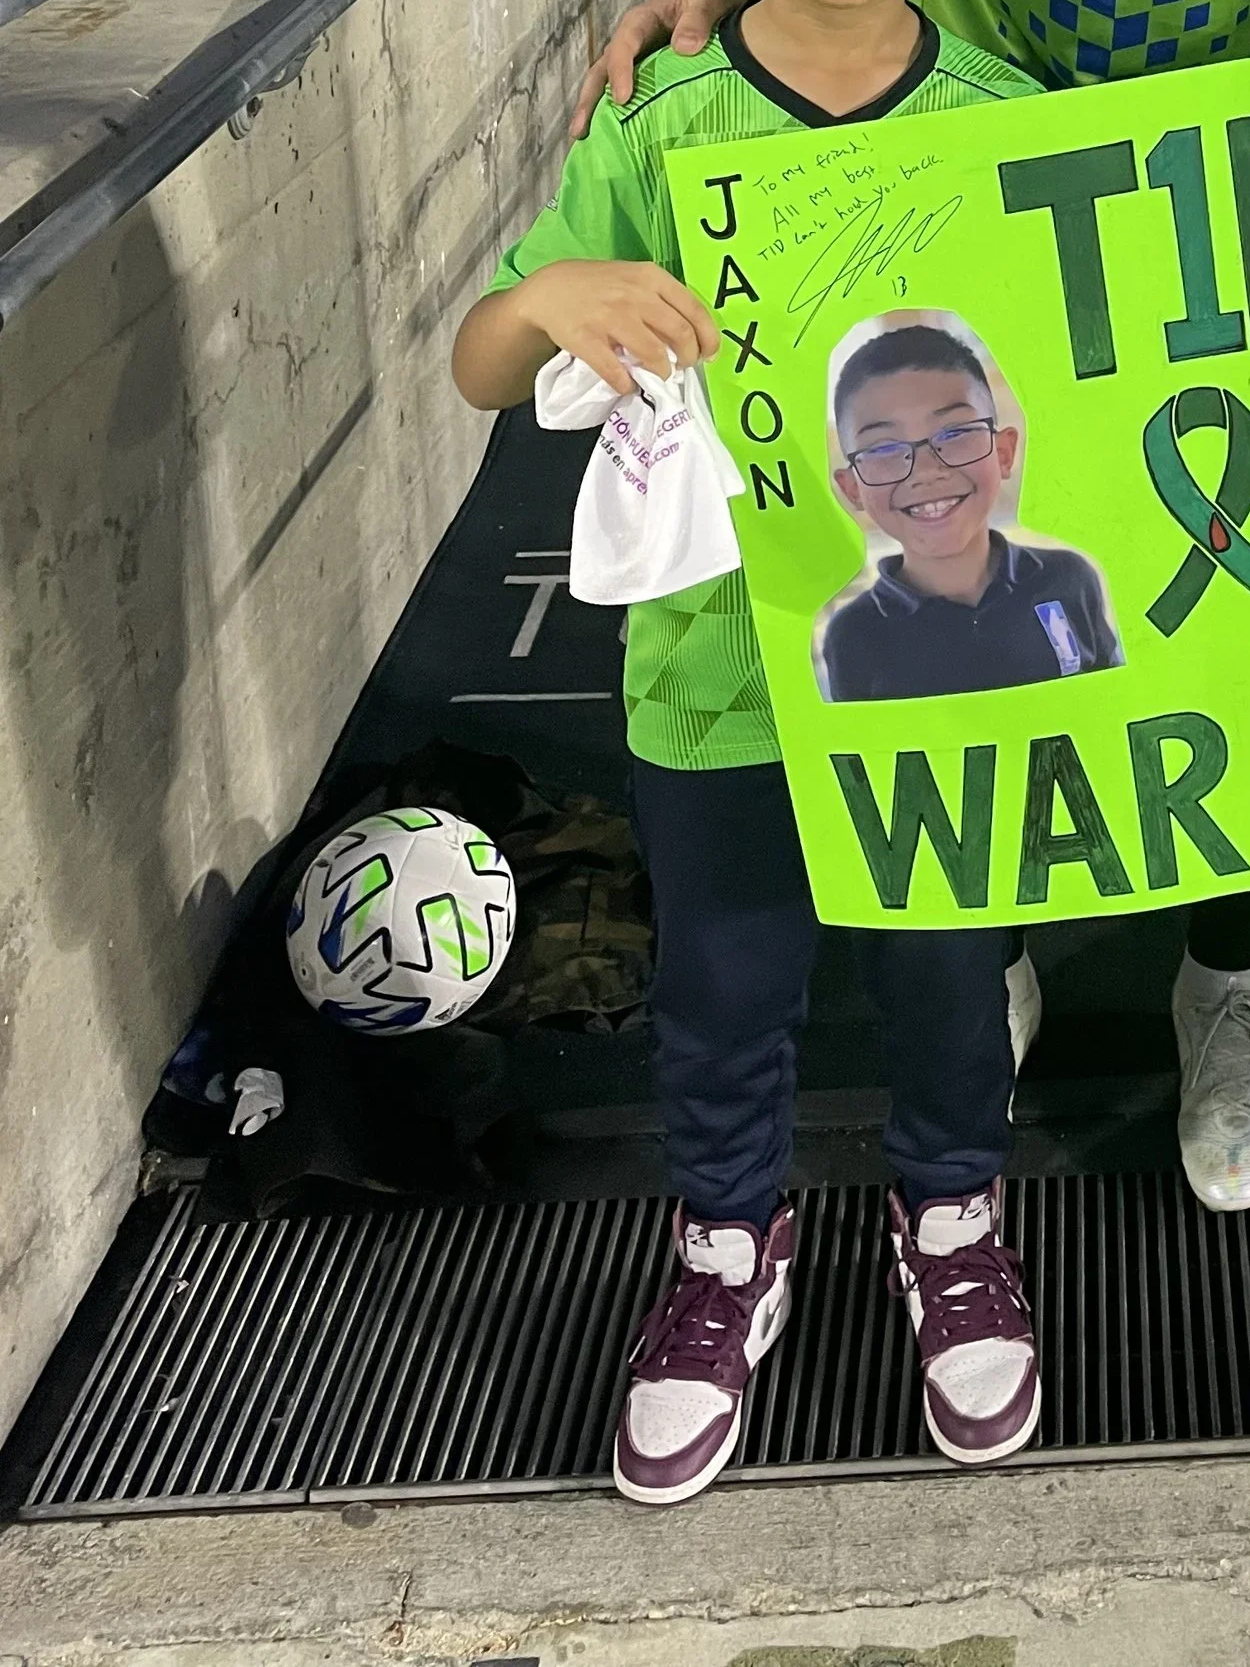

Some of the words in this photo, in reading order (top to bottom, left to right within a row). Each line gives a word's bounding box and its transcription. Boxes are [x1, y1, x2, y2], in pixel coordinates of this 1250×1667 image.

[753, 174, 777, 196] To
[816, 132, 874, 168] friend!
[772, 203, 800, 234] All
[834, 196, 869, 220] hold
[891, 275, 908, 298] 13
[700, 173, 795, 511] JAXON
[656, 408, 696, 438] EGERT
[612, 454, 626, 471] en
